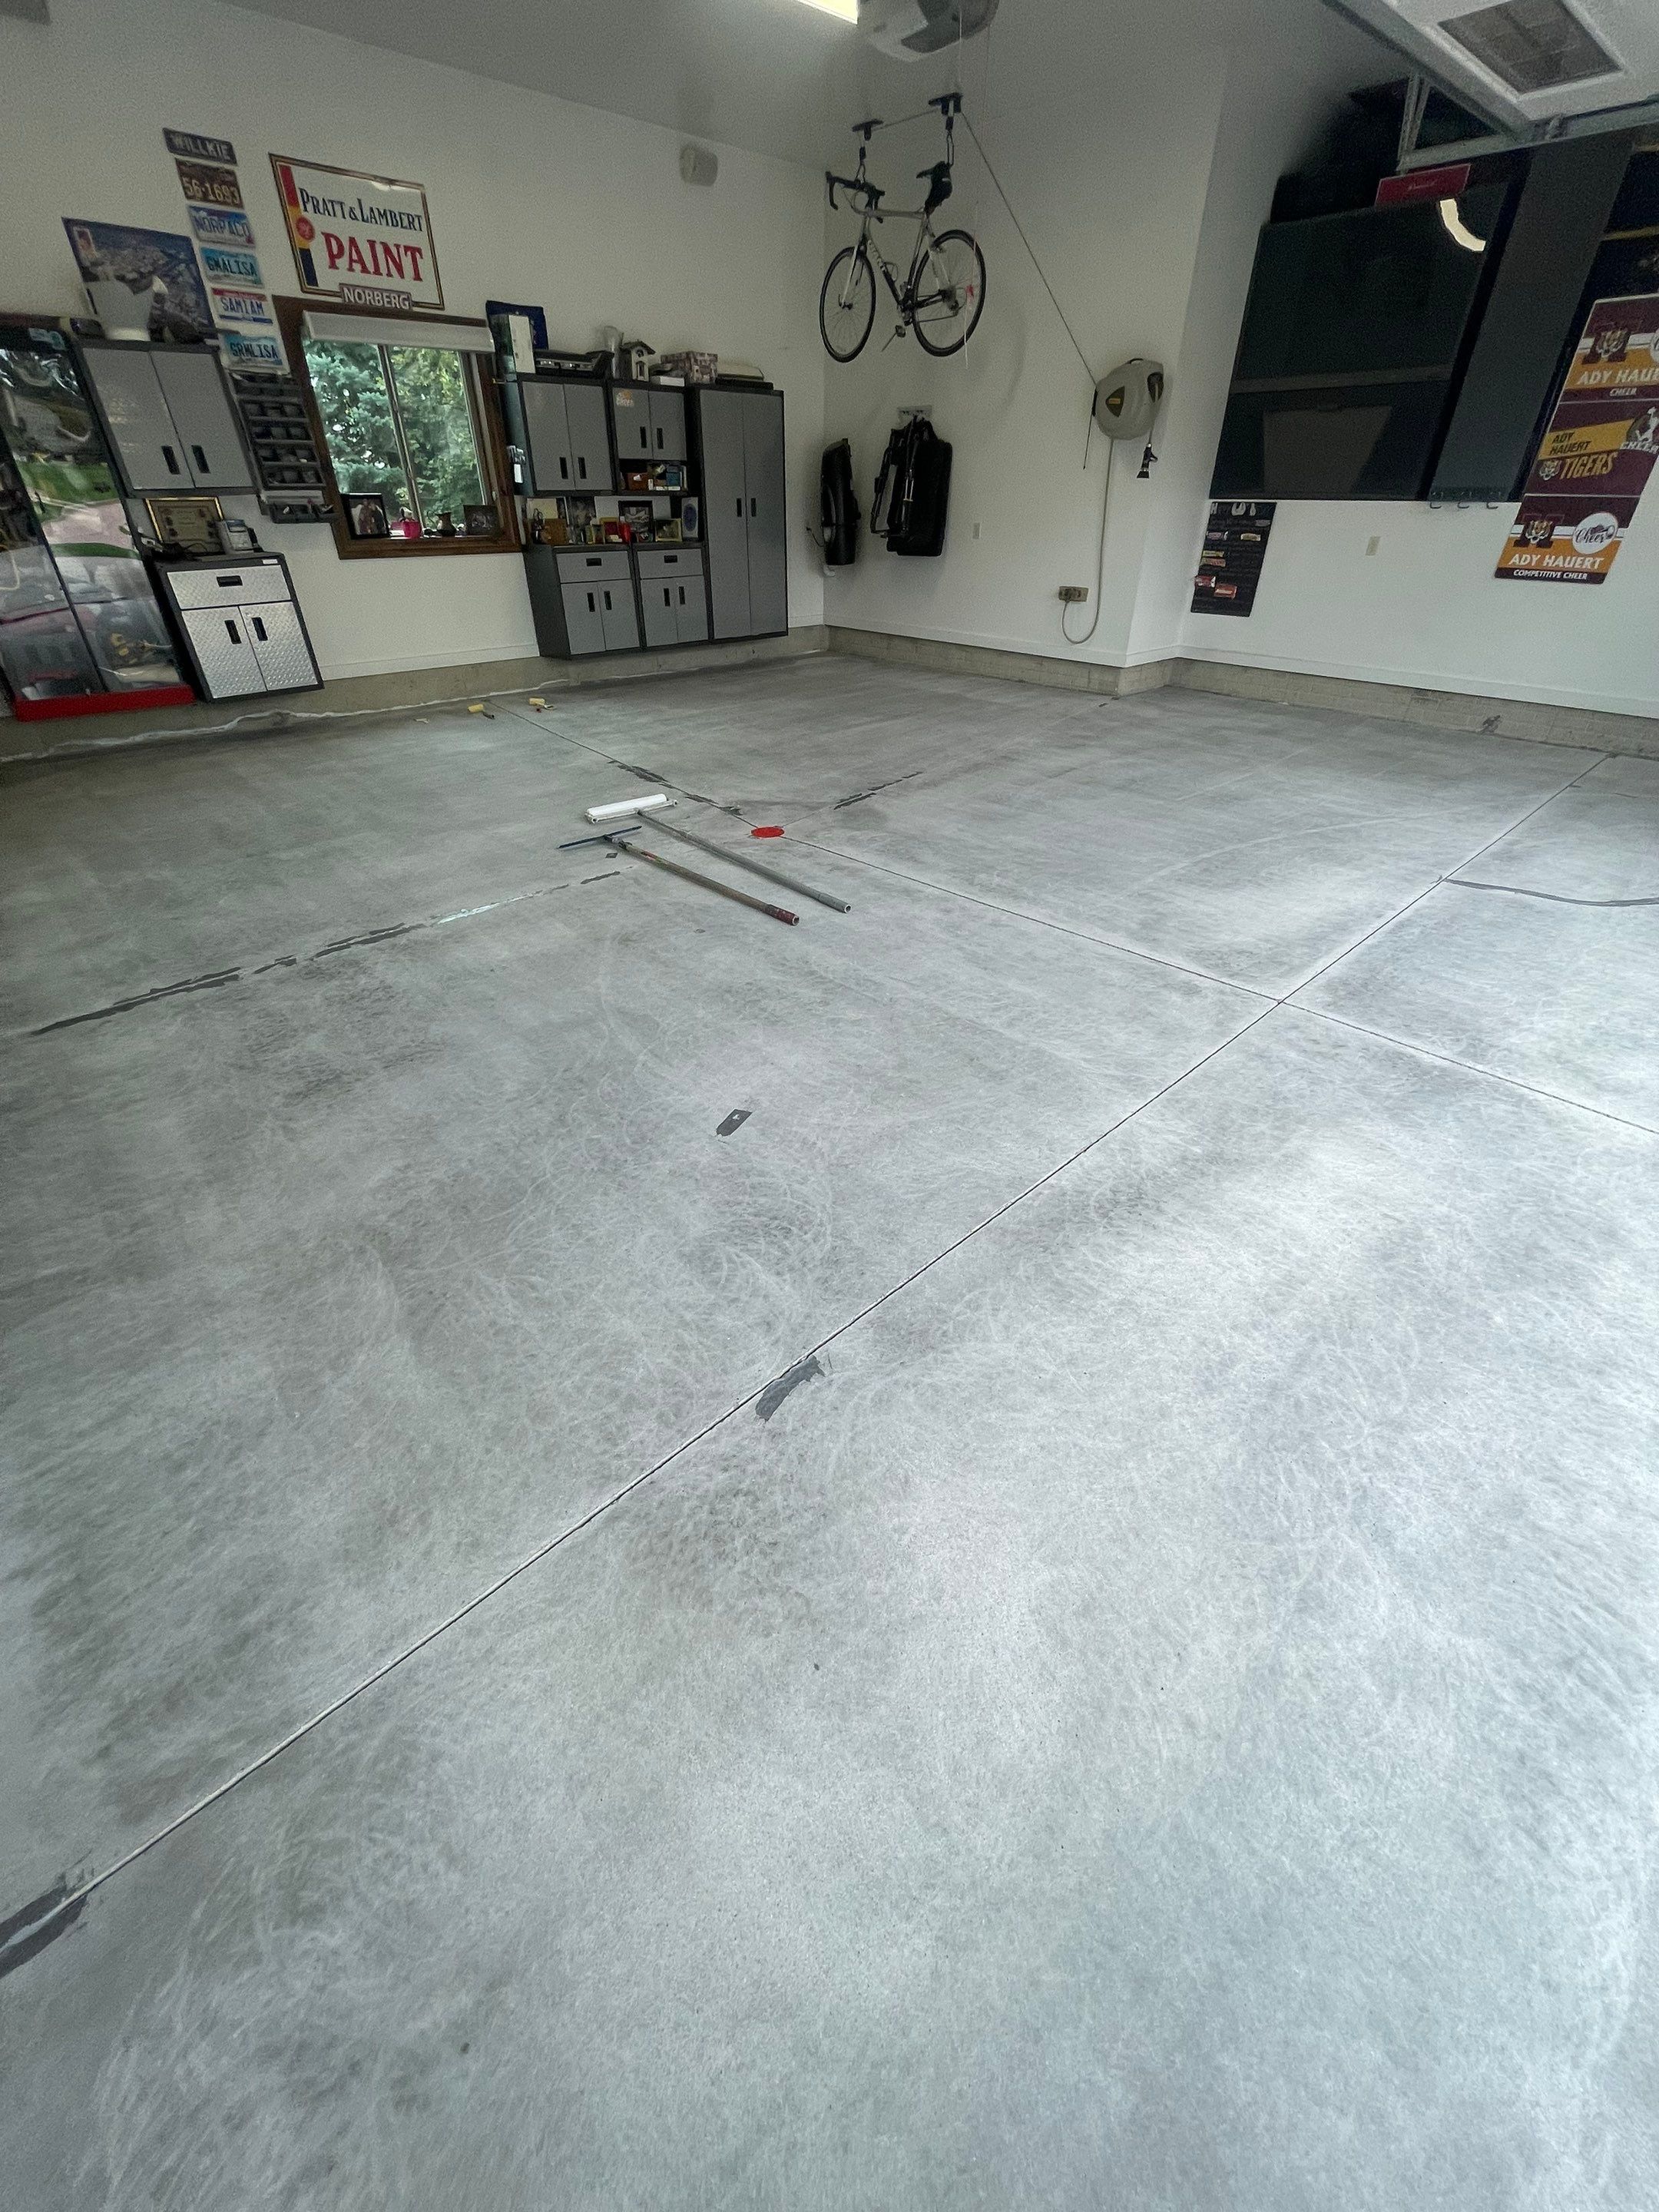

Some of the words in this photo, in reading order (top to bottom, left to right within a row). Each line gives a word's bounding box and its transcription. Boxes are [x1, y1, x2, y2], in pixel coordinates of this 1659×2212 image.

[298, 187, 346, 220] PRATT
[356, 197, 423, 232] LAMBERT
[321, 231, 423, 282] PAINT
[343, 287, 411, 310] NORBERG
[1577, 369, 1613, 385] ADY
[1609, 388, 1637, 396] CHEER
[1552, 432, 1575, 444] ADY
[1549, 441, 1592, 455] HAUERT
[1559, 452, 1618, 480] TIGERS
[1575, 527, 1605, 543] Cheer
[1508, 554, 1541, 566] ADY
[1543, 555, 1605, 569] HAUERT
[1513, 569, 1561, 578] COMPETITIVE
[1563, 571, 1588, 580] CHEER
